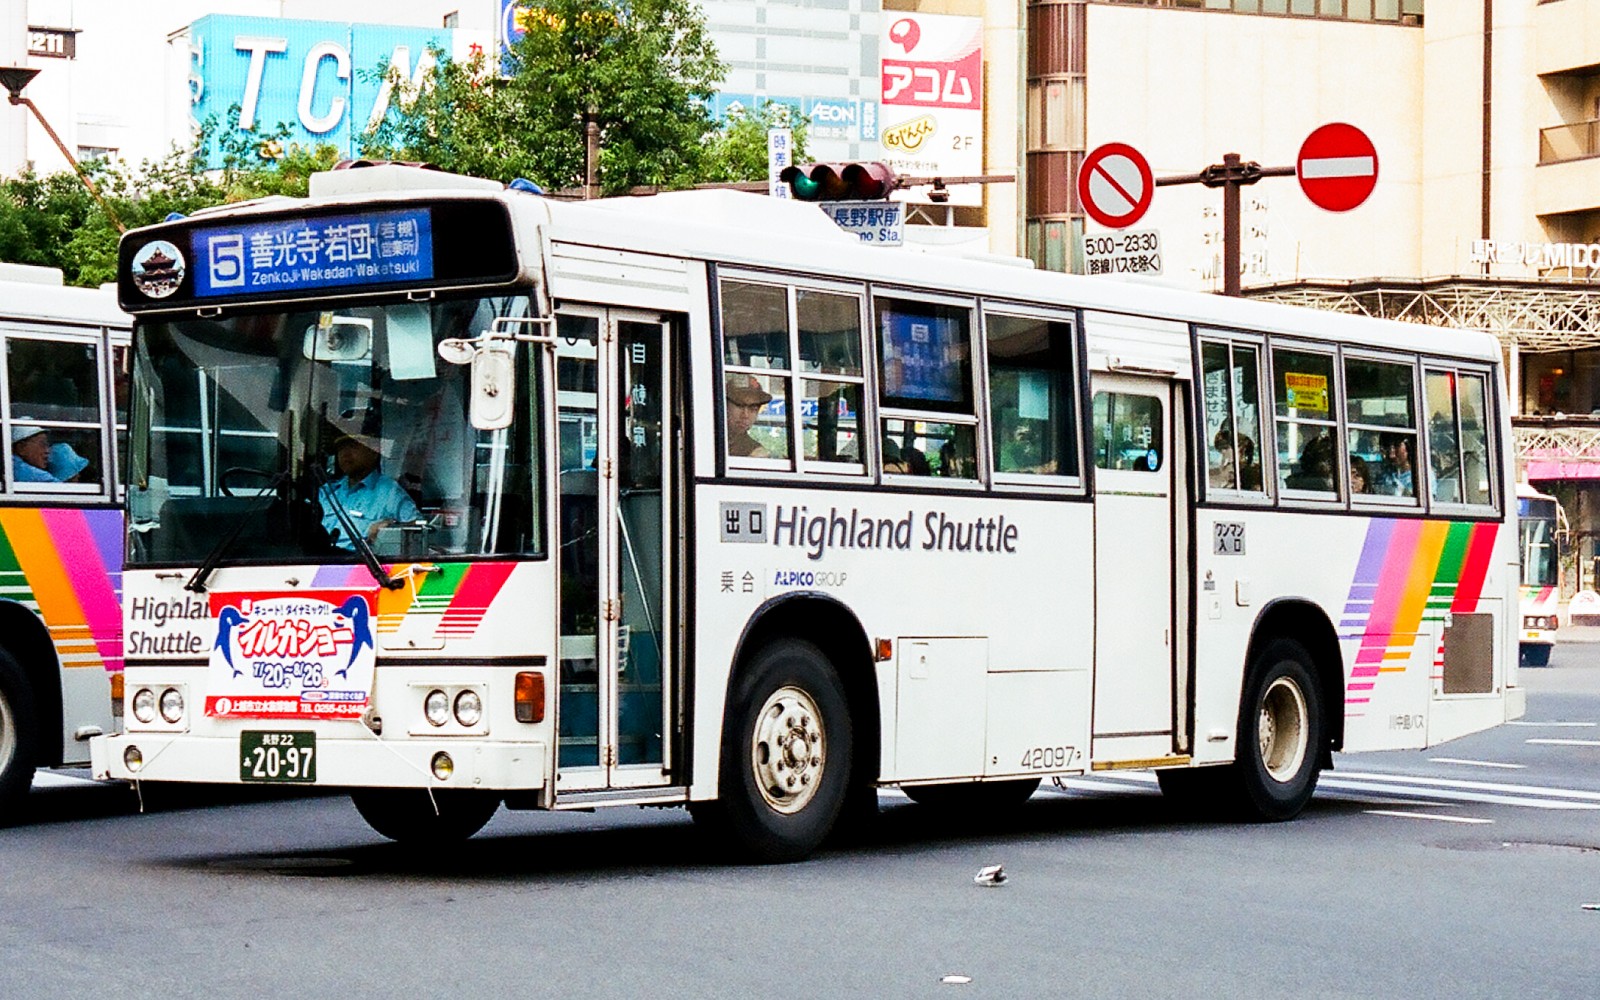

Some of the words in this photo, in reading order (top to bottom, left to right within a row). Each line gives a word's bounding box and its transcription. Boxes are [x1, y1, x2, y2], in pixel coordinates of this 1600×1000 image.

[883, 65, 973, 103] アコム
[887, 120, 933, 156] むじんくん
[952, 135, 973, 150] 2F
[834, 207, 900, 227] 長野駅前
[879, 228, 901, 242] Sta.
[726, 509, 762, 534] 出口
[773, 505, 913, 560] Highland
[922, 511, 1018, 553] Shuttle
[1215, 522, 1244, 537] ワンマン
[1218, 538, 1241, 552] 入口
[720, 570, 755, 594] 乗合
[127, 630, 202, 654] Shuttle
[237, 618, 355, 659] イルカショー
[1021, 745, 1075, 770] 42097
